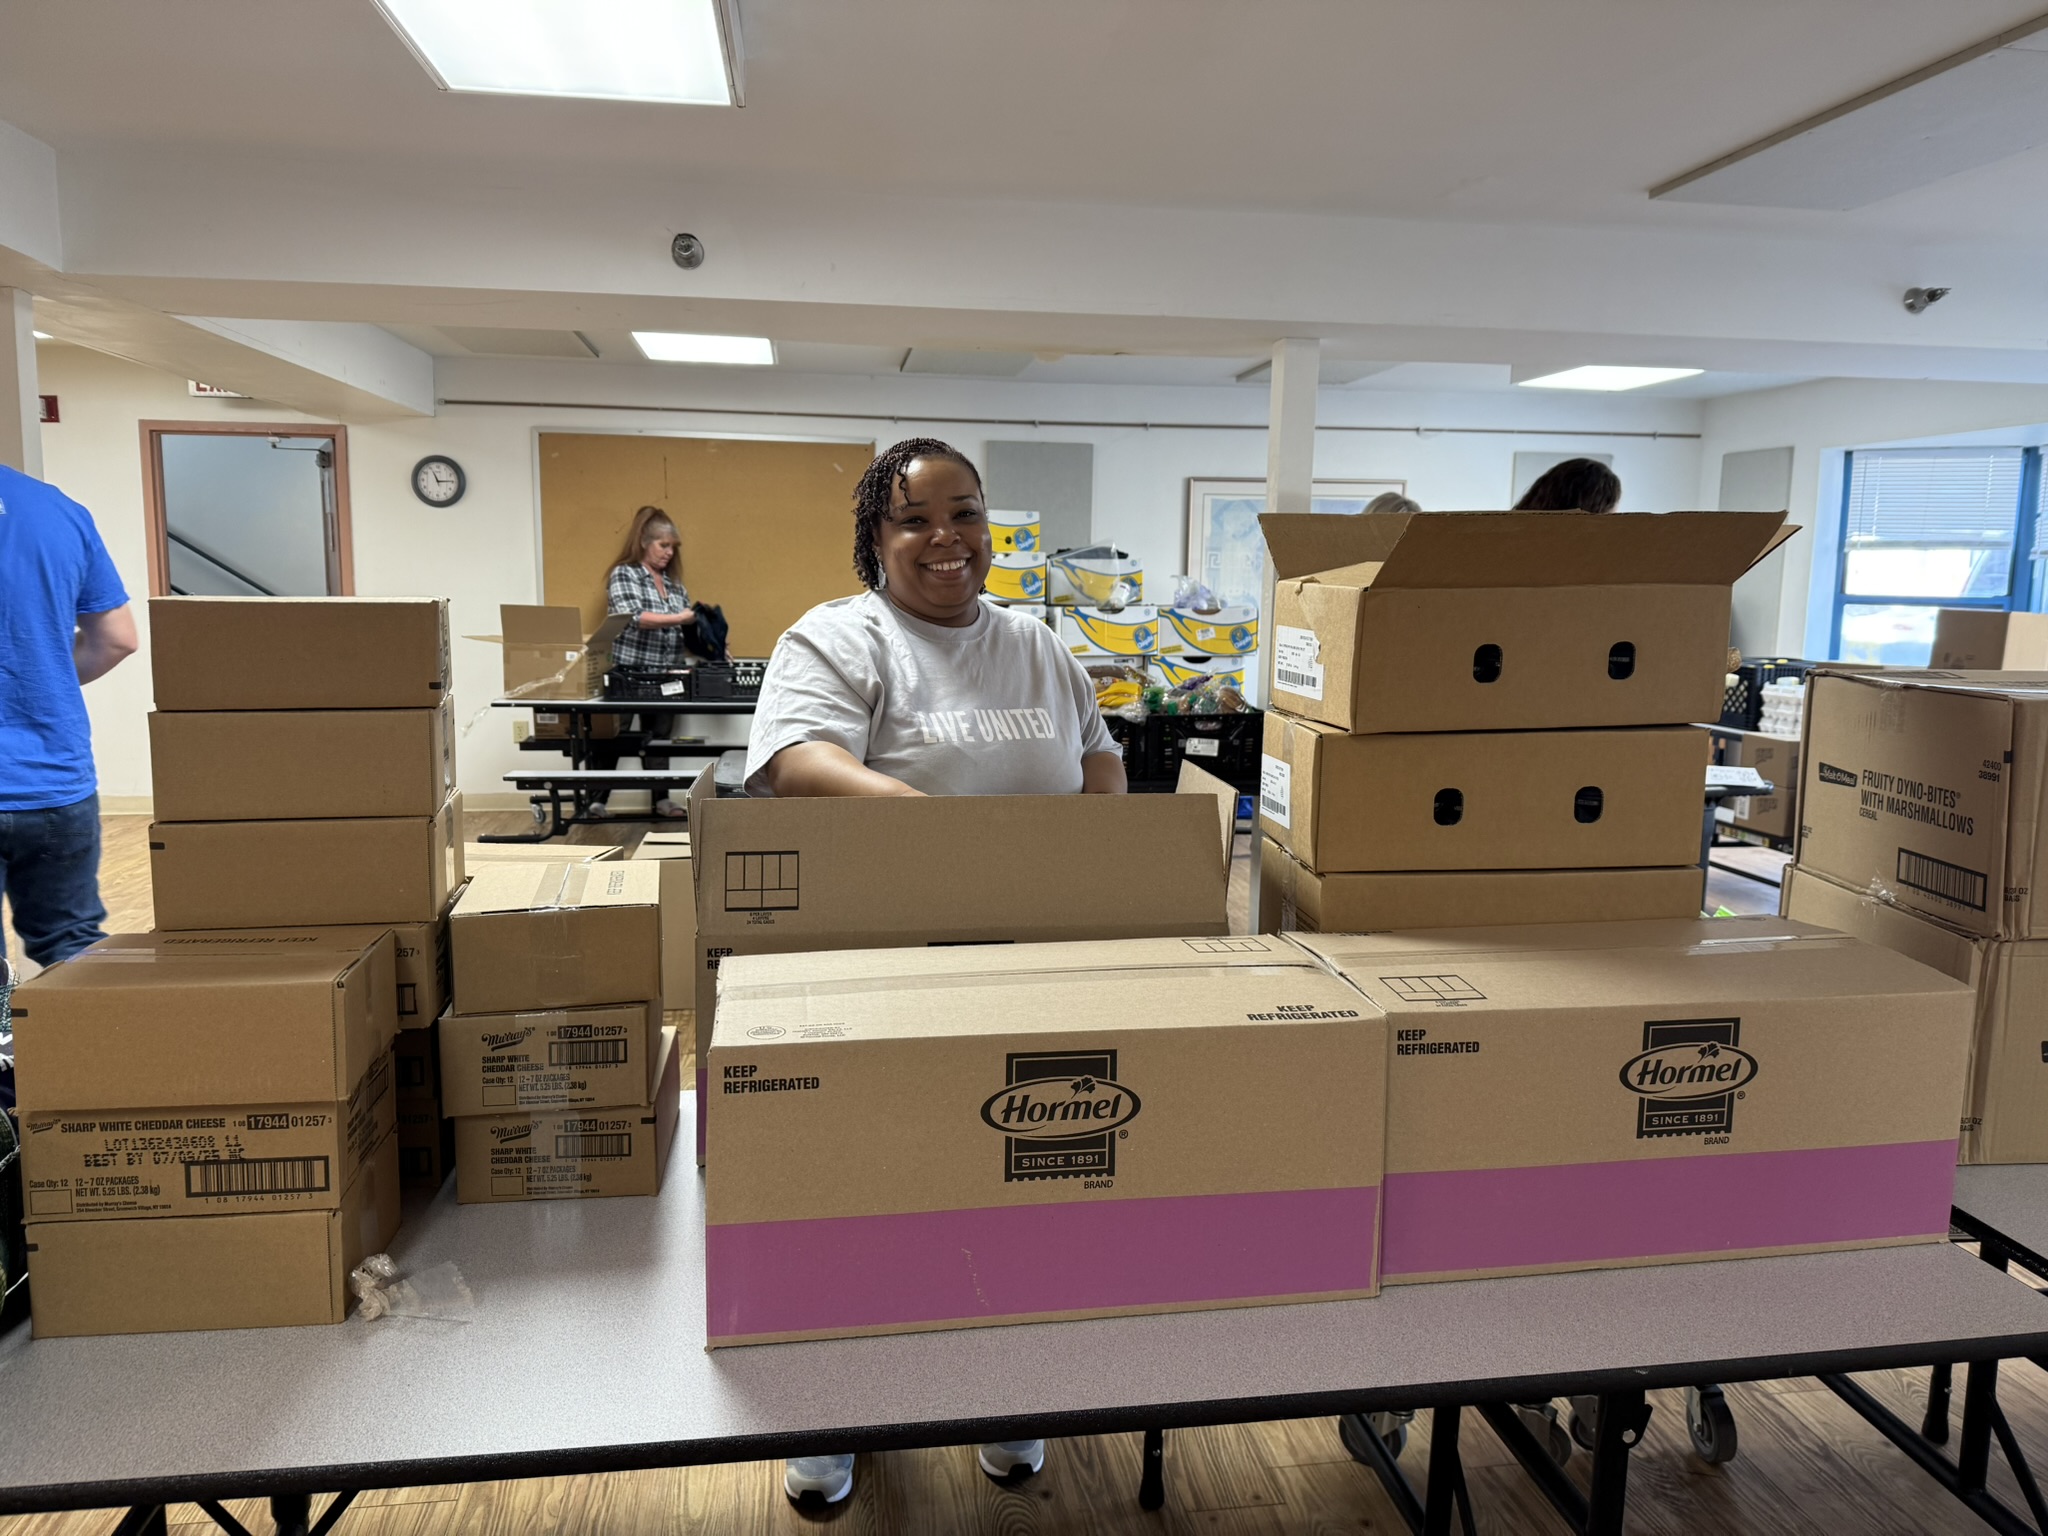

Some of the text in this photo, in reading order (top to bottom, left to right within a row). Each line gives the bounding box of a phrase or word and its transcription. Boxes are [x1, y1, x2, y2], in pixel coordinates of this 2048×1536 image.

[917, 707, 1056, 744] LIVE UNITED
[1982, 760, 2002, 772] 42400
[1862, 769, 1894, 792] FRUITY
[1978, 770, 2001, 783] 38991
[1859, 807, 1878, 821] CEREAL
[1860, 789, 1974, 836] WITH MARSHMALLOWS
[2018, 887, 2029, 896] OZ
[1277, 1004, 1314, 1013] KEEP
[1247, 1010, 1359, 1022] REFRIGERATED
[559, 1026, 592, 1038] 17944
[593, 1026, 623, 1037] 01257
[1397, 1029, 1427, 1041] KEEP
[1397, 1041, 1480, 1056] REFRIGERATED
[482, 1055, 530, 1064] SHARP WHITE
[482, 1063, 544, 1073] CHEDDAR CHEESE
[724, 1065, 758, 1079] KEEP
[1637, 1058, 1742, 1086] Hormel
[724, 1076, 820, 1094] REFRIGERATED
[1001, 1093, 1122, 1124] Hormel
[61, 1122, 97, 1133] SHARP
[99, 1121, 132, 1131] WHITE
[134, 1119, 183, 1130] CHEDDAR
[186, 1118, 226, 1129] CHEESE
[248, 1115, 288, 1129] 17944
[291, 1115, 326, 1127] 01257
[1652, 1113, 1719, 1125] SINCE 1891
[565, 1120, 597, 1132] 17944
[598, 1120, 627, 1131] 01257
[1704, 1136, 1730, 1145] BRAND
[491, 1147, 537, 1156] SHARP WHITE
[83, 1152, 118, 1168] BEST
[126, 1152, 144, 1166] BY
[491, 1155, 550, 1165] CHEDDAR CHEESE
[1022, 1154, 1099, 1167] SINCE 1891
[550, 1165, 576, 1173] PACKAGES
[75, 1178, 83, 1186] 12
[105, 1176, 139, 1185] PACKAGES
[583, 1173, 592, 1182] kg)
[46, 1180, 59, 1189] Qty:
[1083, 1179, 1114, 1189] BRAND
[75, 1185, 160, 1197] NET WT. 5.25 LBS. (2.38 kg)
